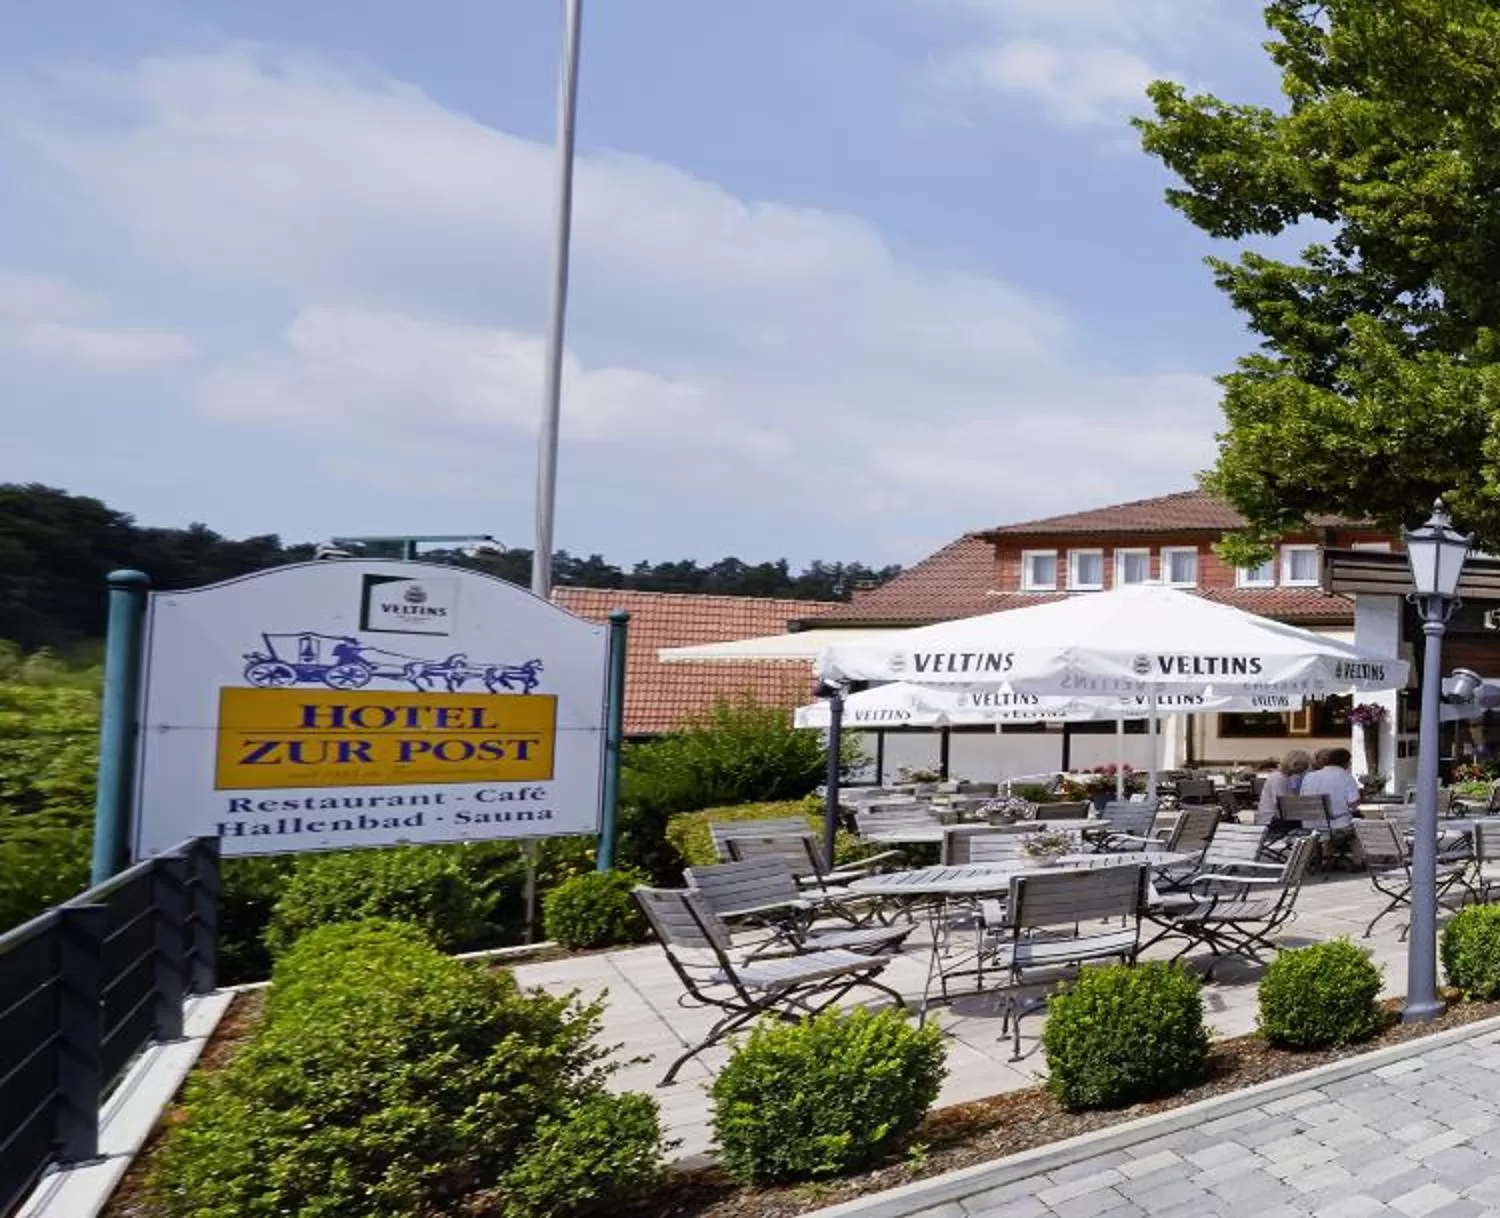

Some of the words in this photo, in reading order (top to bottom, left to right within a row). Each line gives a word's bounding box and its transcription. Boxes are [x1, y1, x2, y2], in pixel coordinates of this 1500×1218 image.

[381, 603, 447, 616] VELTINS
[914, 652, 1016, 673] VELTINS
[1157, 655, 1263, 675] VELTINS
[1344, 662, 1386, 681] VELTINS
[972, 691, 1040, 707] VELTINS
[296, 703, 498, 729] HOTEL
[855, 708, 912, 722] VELTINS
[239, 739, 376, 765] ZUR
[395, 738, 541, 764] POST
[228, 791, 446, 813] Restaurant
[475, 786, 547, 804] Café
[216, 811, 424, 837] Hallenbad
[453, 807, 553, 825] Sauna
